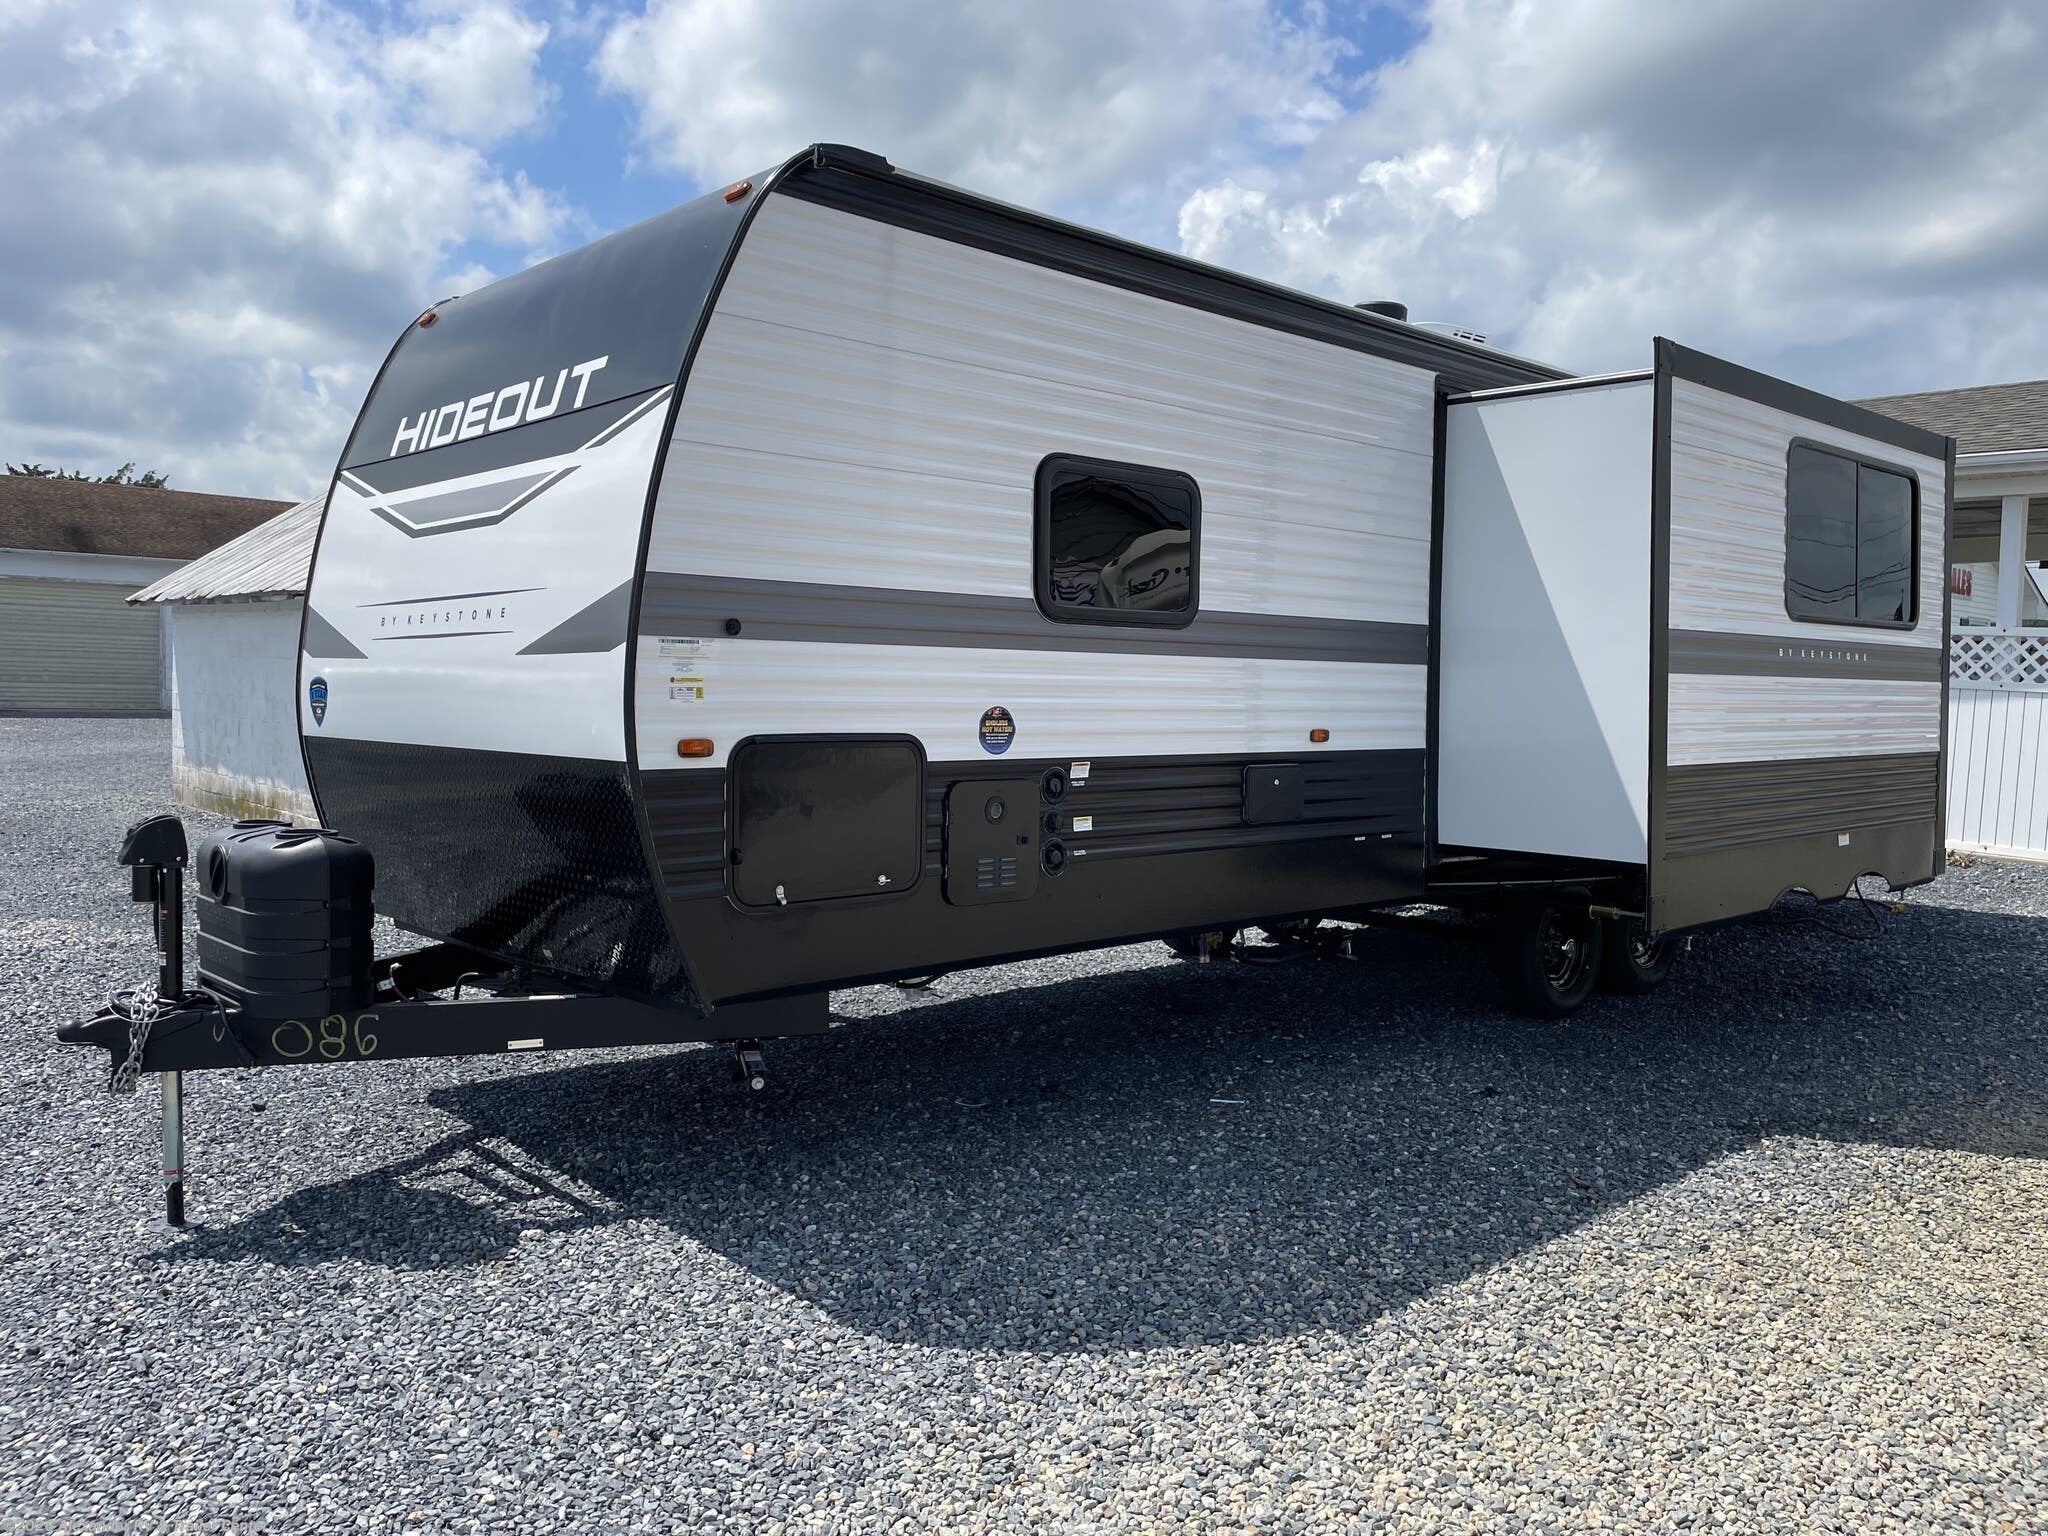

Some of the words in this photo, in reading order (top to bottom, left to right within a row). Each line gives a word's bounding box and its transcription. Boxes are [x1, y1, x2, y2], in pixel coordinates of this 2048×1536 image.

[389, 355, 609, 457] HIDEOUT
[380, 616, 398, 627] BY
[407, 607, 506, 625] KEYSTONE
[1779, 648, 1793, 657] BY
[1801, 649, 1867, 662] KEYSTONE
[272, 1014, 379, 1059] 086
